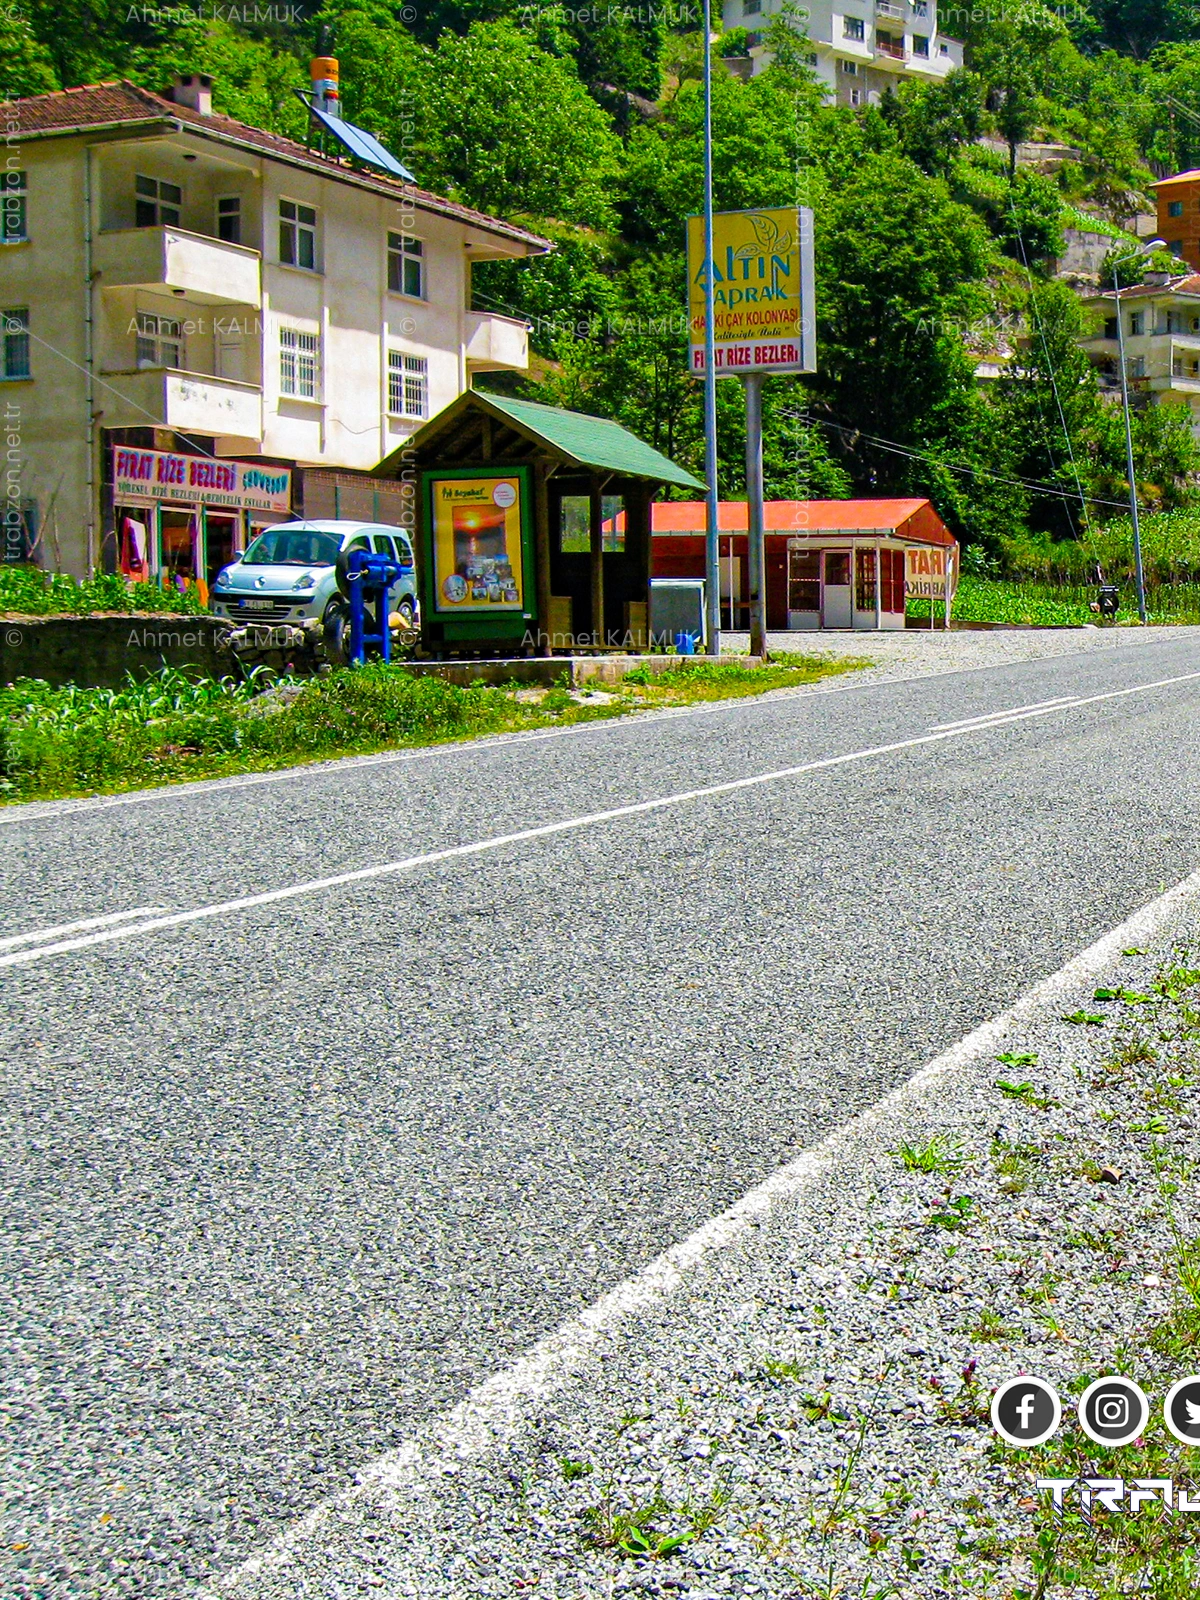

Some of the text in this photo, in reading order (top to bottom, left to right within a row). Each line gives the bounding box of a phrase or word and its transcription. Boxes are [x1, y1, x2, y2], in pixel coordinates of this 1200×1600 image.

[726, 311, 743, 328] ÇAY
[746, 308, 798, 325] KOLONYASI
[727, 344, 750, 366] RİZE
